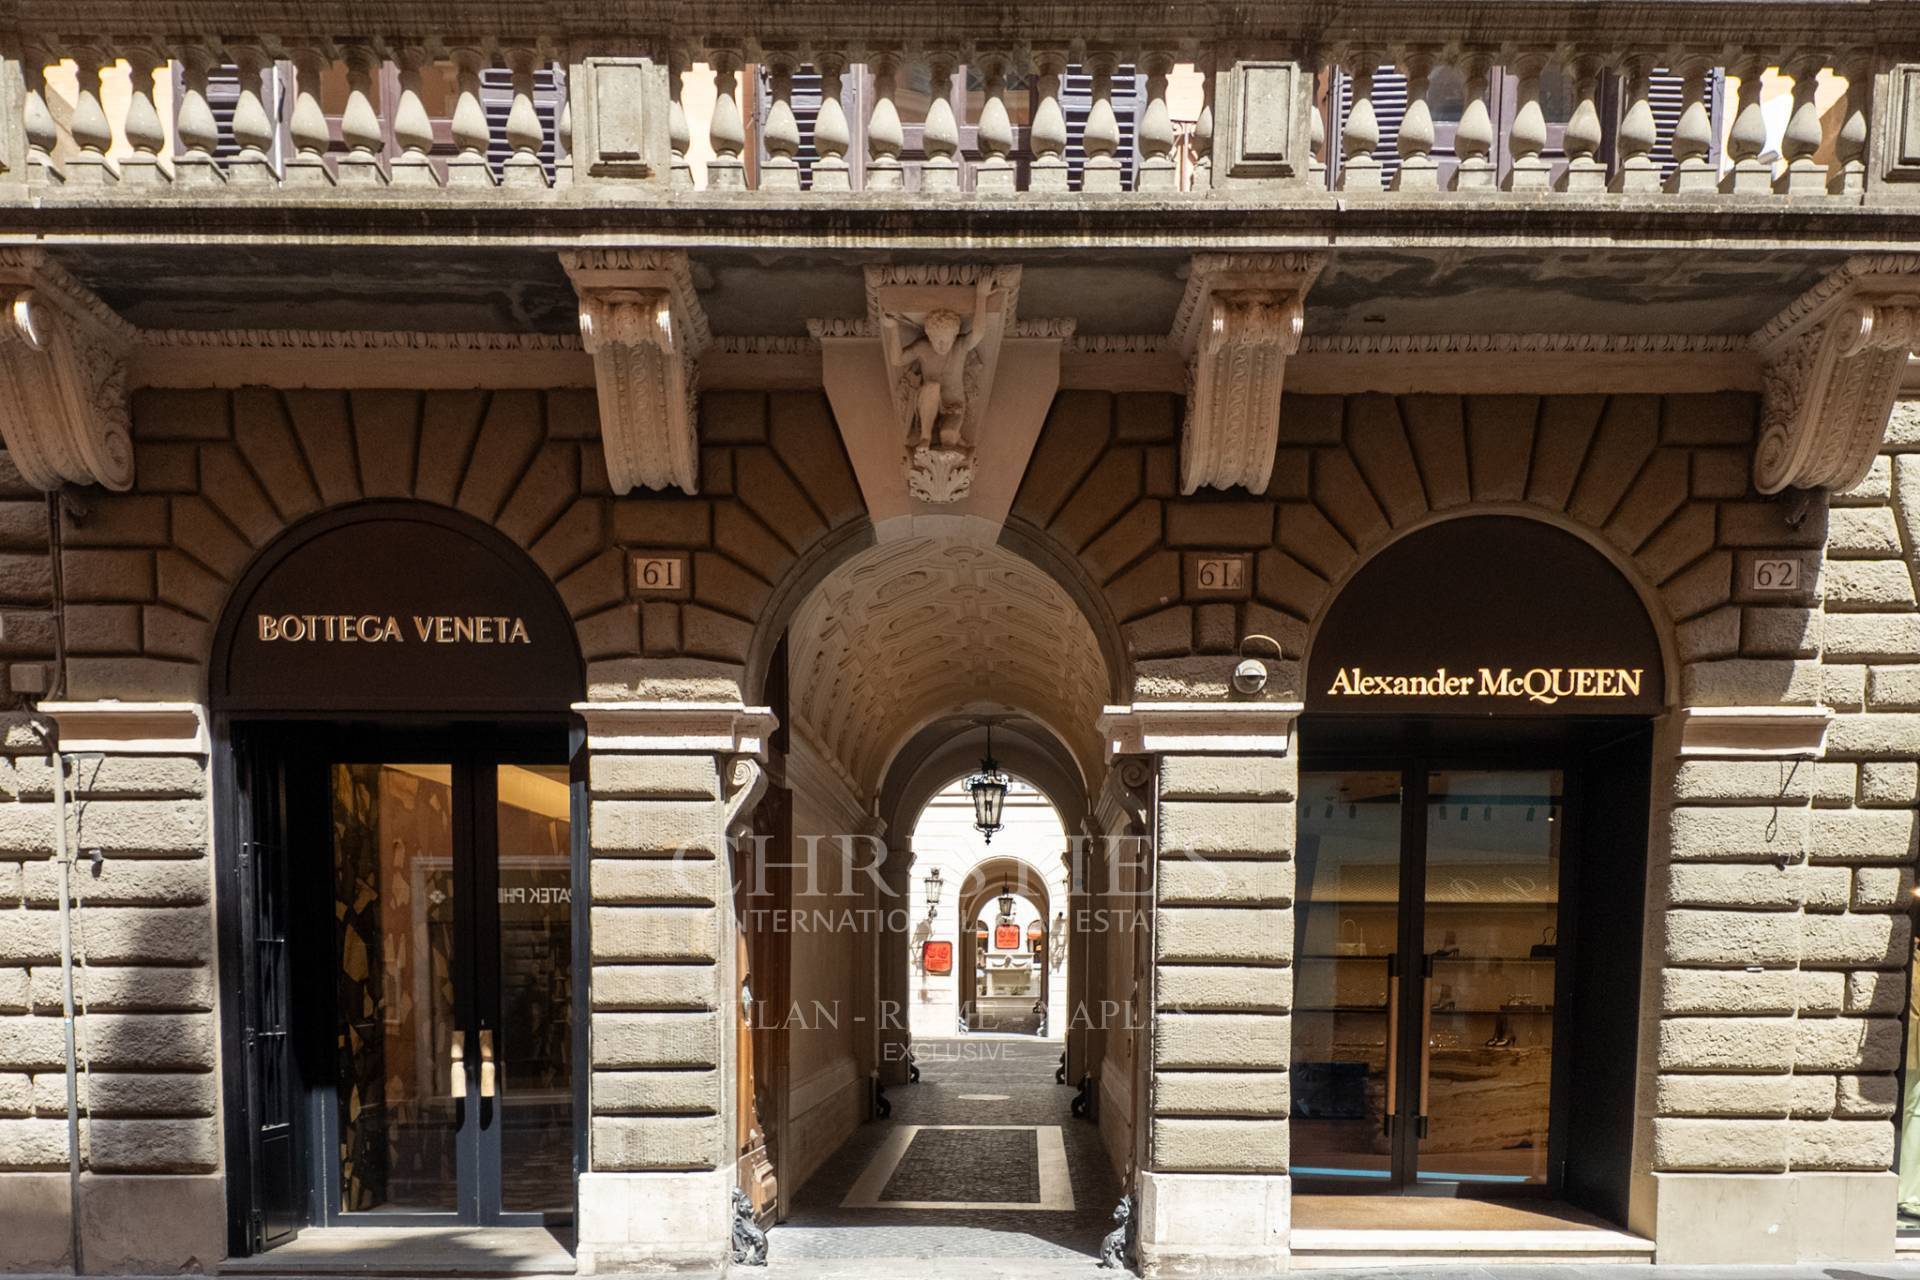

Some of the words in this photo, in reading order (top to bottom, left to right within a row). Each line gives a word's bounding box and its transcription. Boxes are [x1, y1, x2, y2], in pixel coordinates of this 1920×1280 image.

[643, 560, 674, 586] 61
[1757, 561, 1794, 586] 62
[258, 614, 404, 643] BOTTEGA
[413, 615, 531, 644] VENETA
[1327, 666, 1474, 696] Alexander
[1478, 667, 1644, 704] McQUEEN
